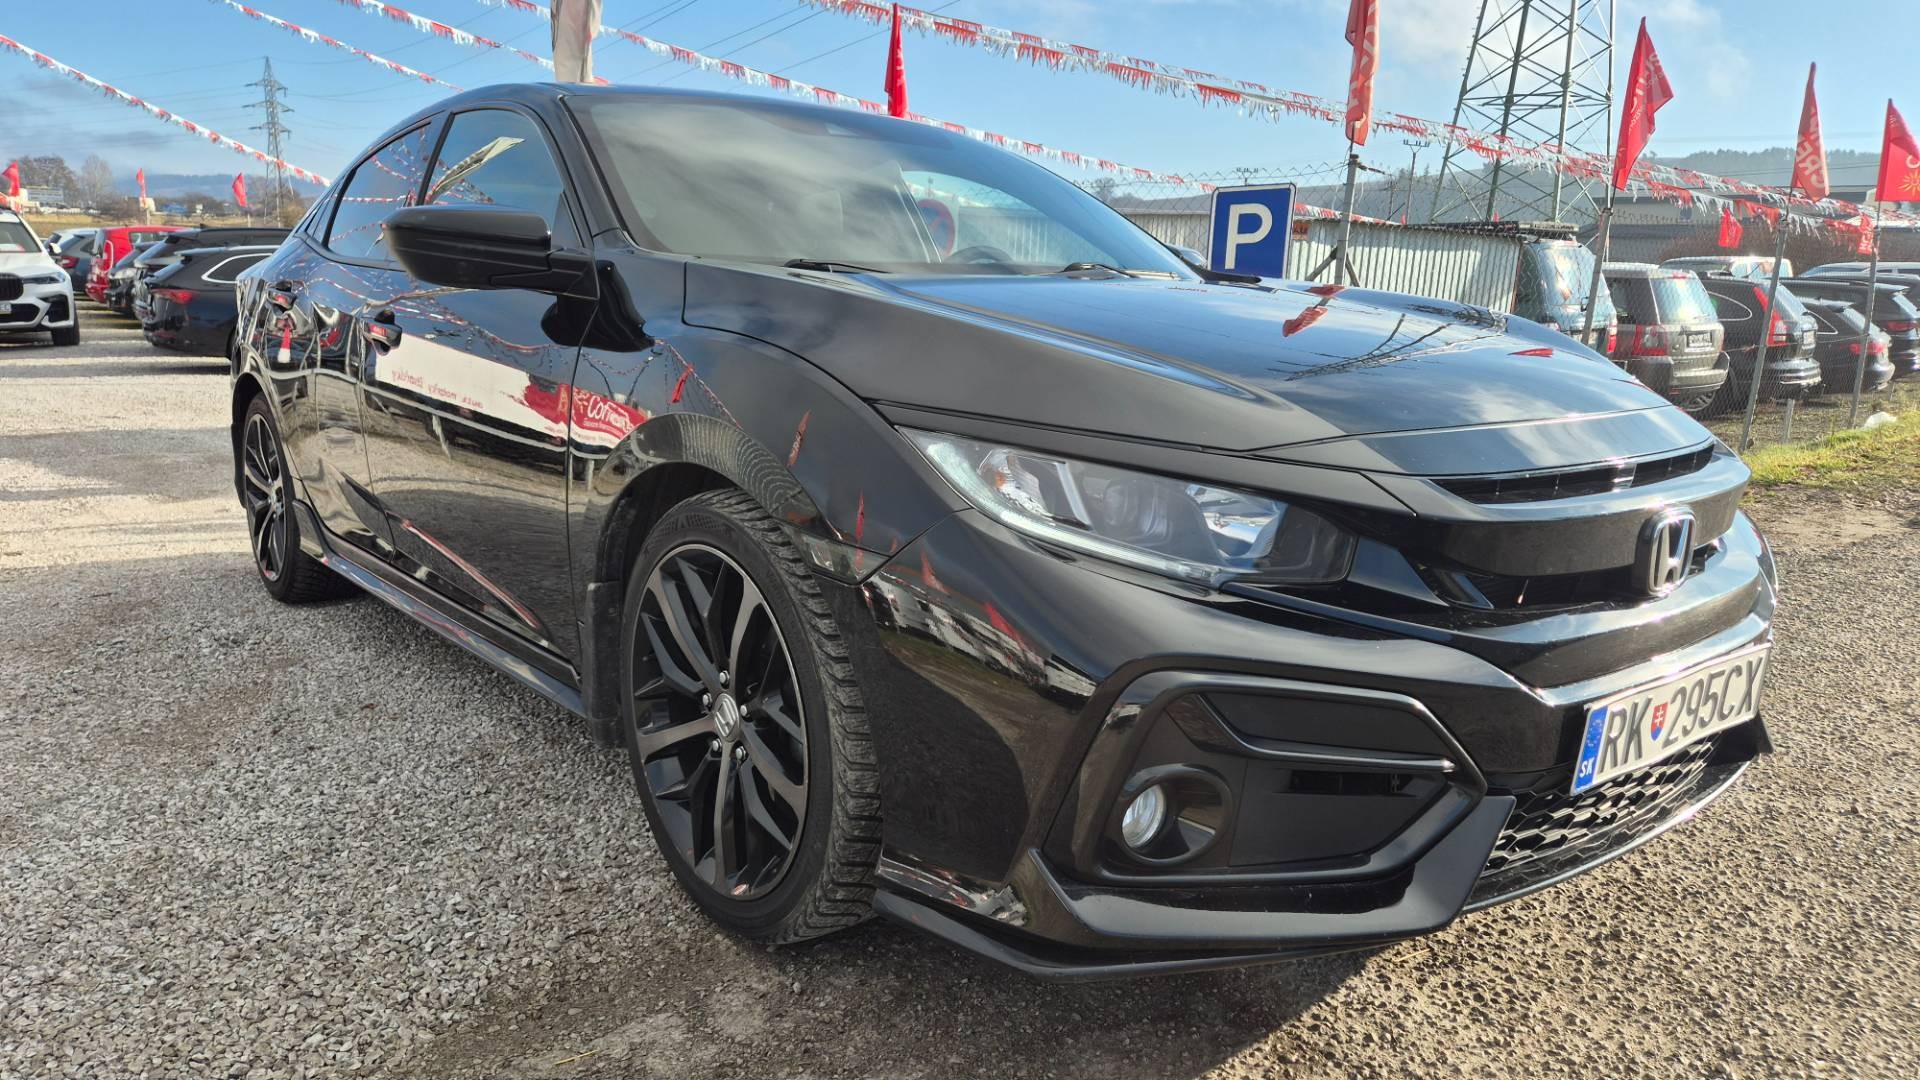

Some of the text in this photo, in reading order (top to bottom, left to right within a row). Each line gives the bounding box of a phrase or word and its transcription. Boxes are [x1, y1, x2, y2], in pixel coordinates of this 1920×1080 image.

[1224, 203, 1273, 270] P
[1600, 655, 1764, 773] RK 295CX
[1579, 756, 1596, 778] SK
